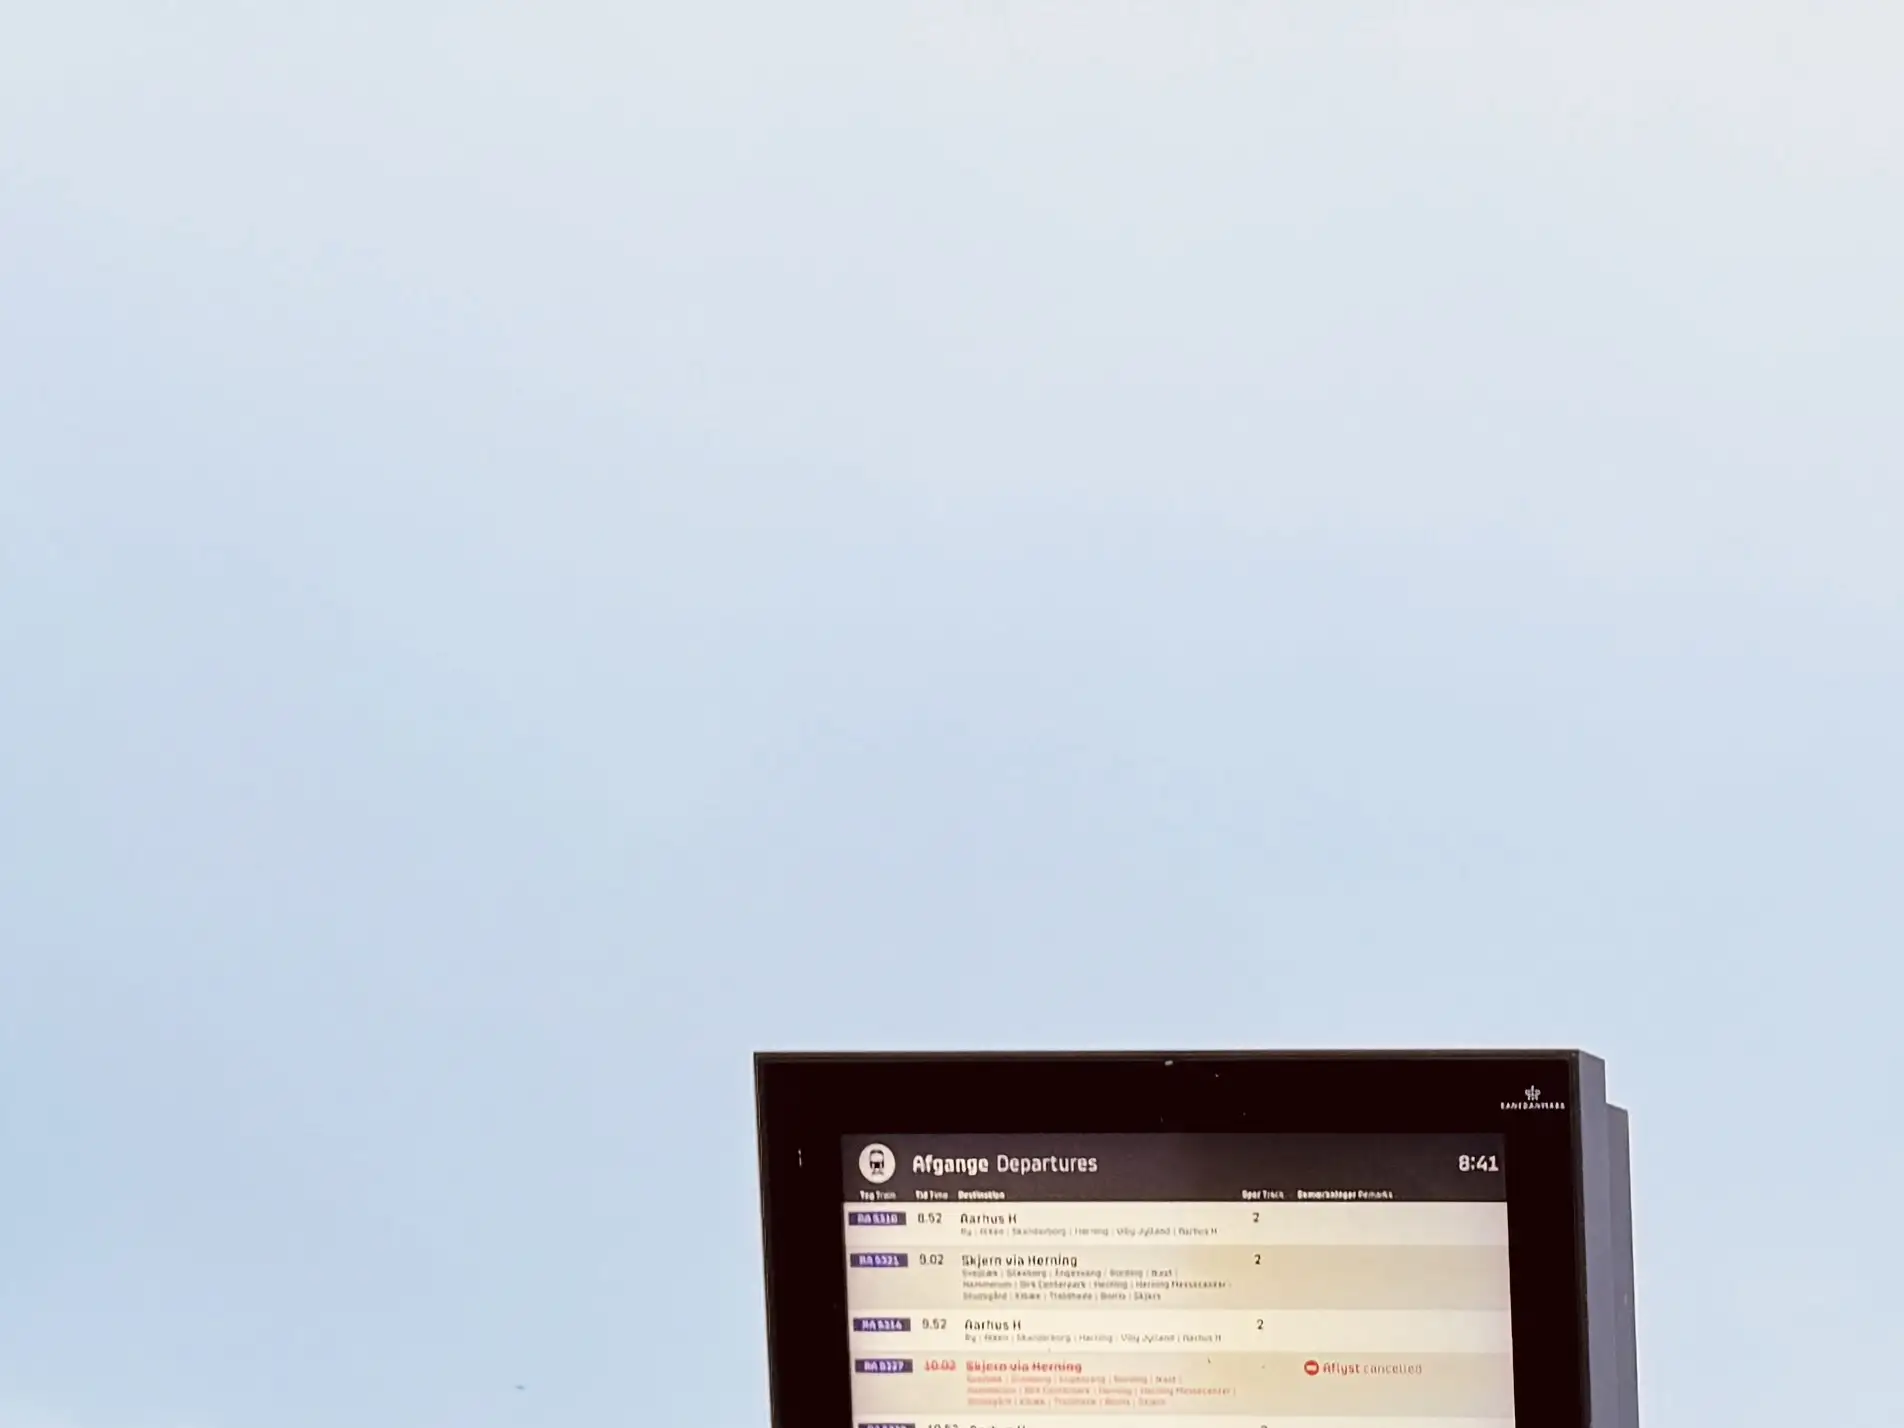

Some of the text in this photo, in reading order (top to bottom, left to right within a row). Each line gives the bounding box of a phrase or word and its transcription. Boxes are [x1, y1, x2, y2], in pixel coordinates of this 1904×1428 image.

[912, 1154, 1099, 1177] Afgange Departures
[1458, 1154, 1500, 1172] 8:41
[1006, 1254, 1024, 1266] via
